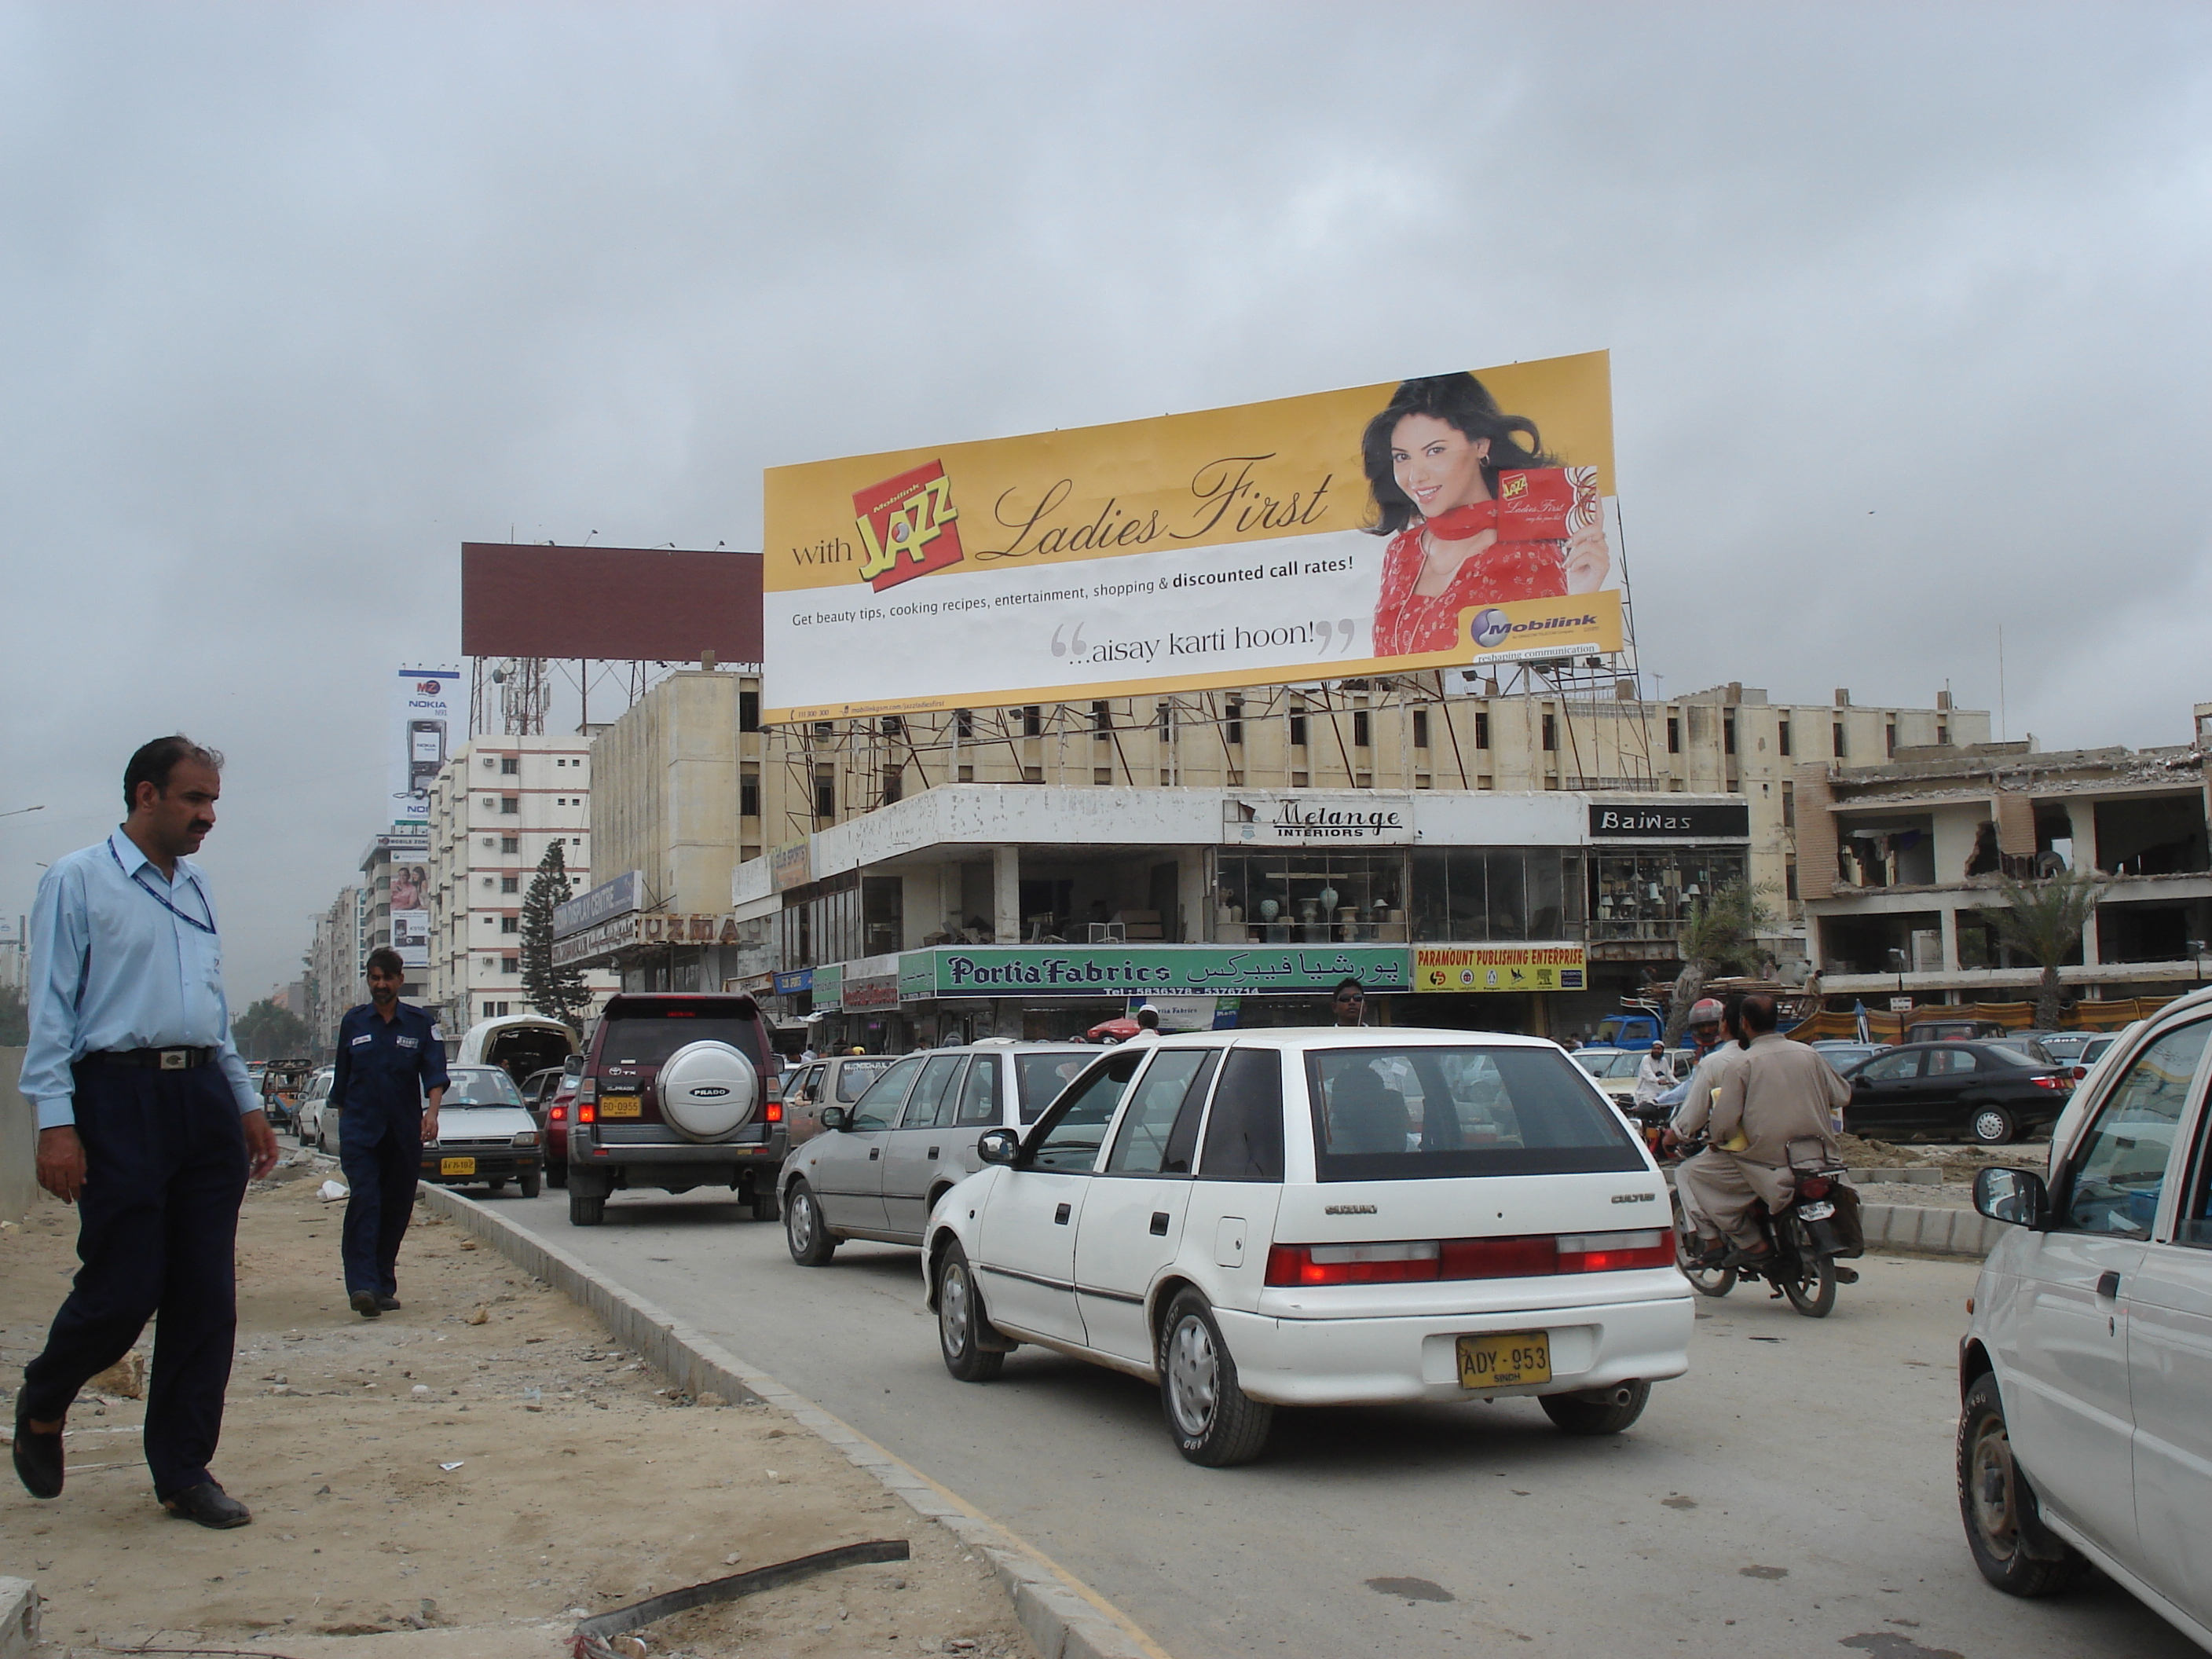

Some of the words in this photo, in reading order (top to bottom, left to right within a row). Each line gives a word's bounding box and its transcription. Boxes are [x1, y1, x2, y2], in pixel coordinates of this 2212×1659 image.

[873, 483, 920, 513] Mobilink
[975, 478, 1168, 561] Ladies
[1169, 453, 1333, 539] First
[1504, 501, 1537, 514] Ladies
[1537, 499, 1565, 513] First
[792, 537, 852, 566] with
[793, 613, 812, 626] Get
[817, 610, 856, 623] beauty
[860, 607, 885, 620] tips,
[890, 602, 938, 616] cooking
[943, 597, 991, 612] recipes,
[995, 589, 1089, 606] entertainment,
[1093, 581, 1154, 597] shopping
[1159, 577, 1168, 590] &
[1173, 565, 1263, 588] discounted
[1270, 560, 1298, 577] call
[1305, 555, 1353, 574] rates!
[1489, 614, 1598, 635] Mobilink
[1169, 628, 1225, 655] karti
[1478, 651, 1522, 664] reshaping
[1524, 644, 1595, 658] communication
[1273, 802, 1401, 837] Melange
[591, 885, 614, 917] CENTRE
[1418, 950, 1474, 967] PARAMOUNT
[1477, 950, 1529, 966] PUBLISHING
[1532, 948, 1583, 965] ENTERPRISE
[947, 956, 1042, 984] Portia
[1042, 958, 1171, 983] Fabrics
[603, 1102, 638, 1111] BD-0955
[1611, 1193, 1655, 1204] CULTUS
[1325, 1204, 1378, 1215] SUZUKI
[1493, 1372, 1521, 1383] SINDH
[1970, 1393, 1986, 1408] 490
